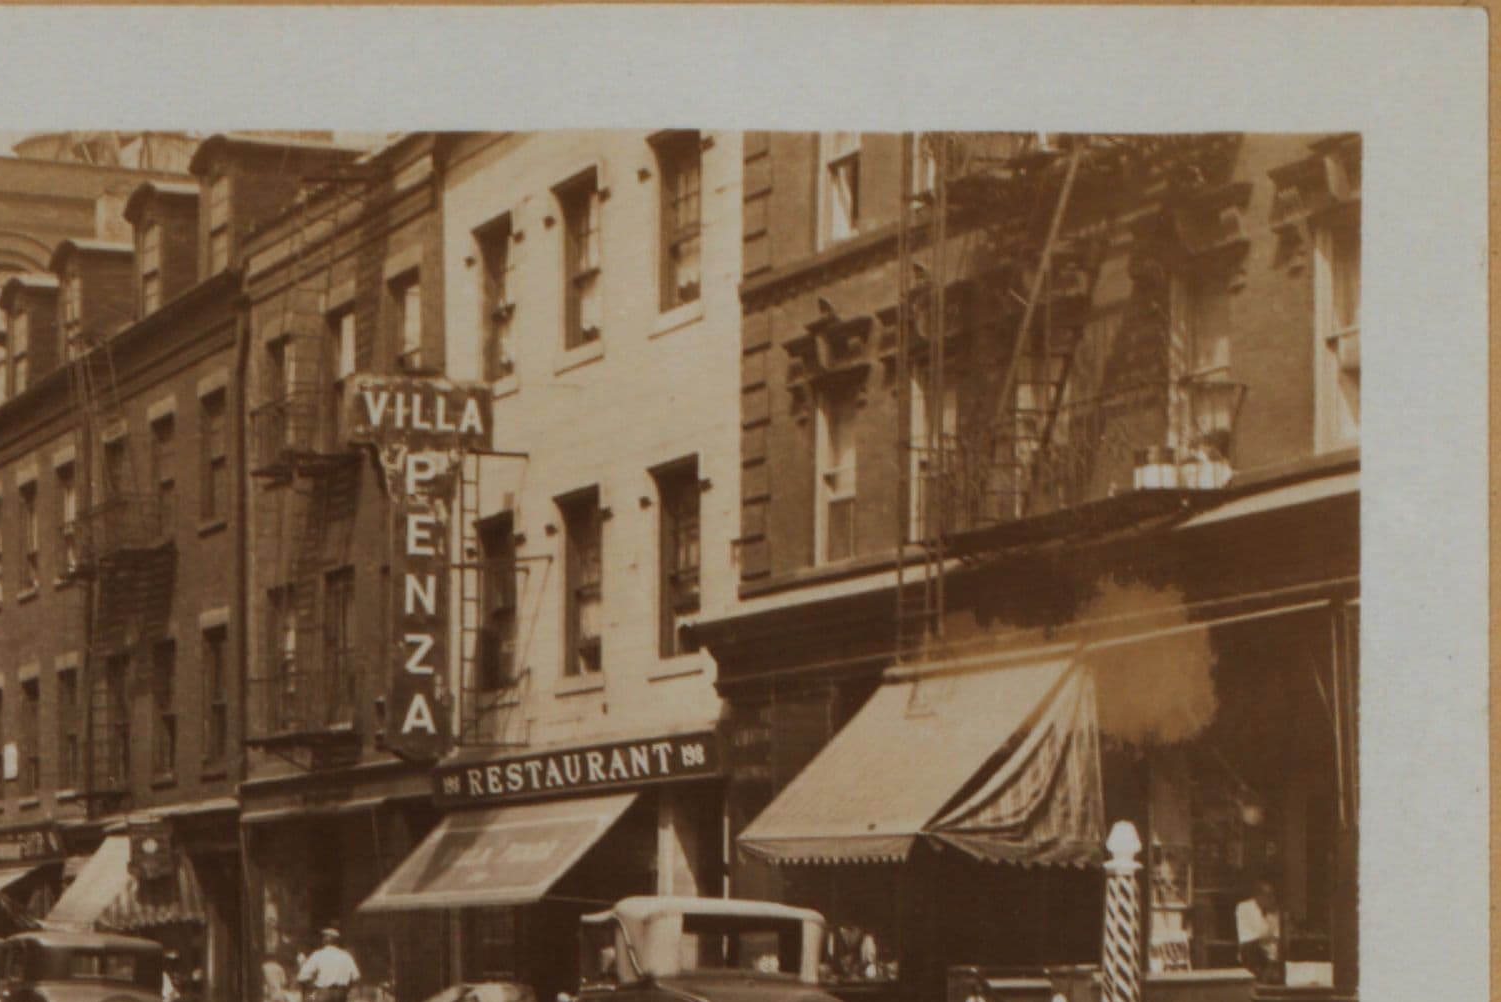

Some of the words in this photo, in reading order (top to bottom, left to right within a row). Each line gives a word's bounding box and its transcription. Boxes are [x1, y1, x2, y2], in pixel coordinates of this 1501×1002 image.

[365, 390, 484, 435] VILLA
[402, 455, 437, 735] PENZA
[467, 742, 673, 796] RESTAURANT
